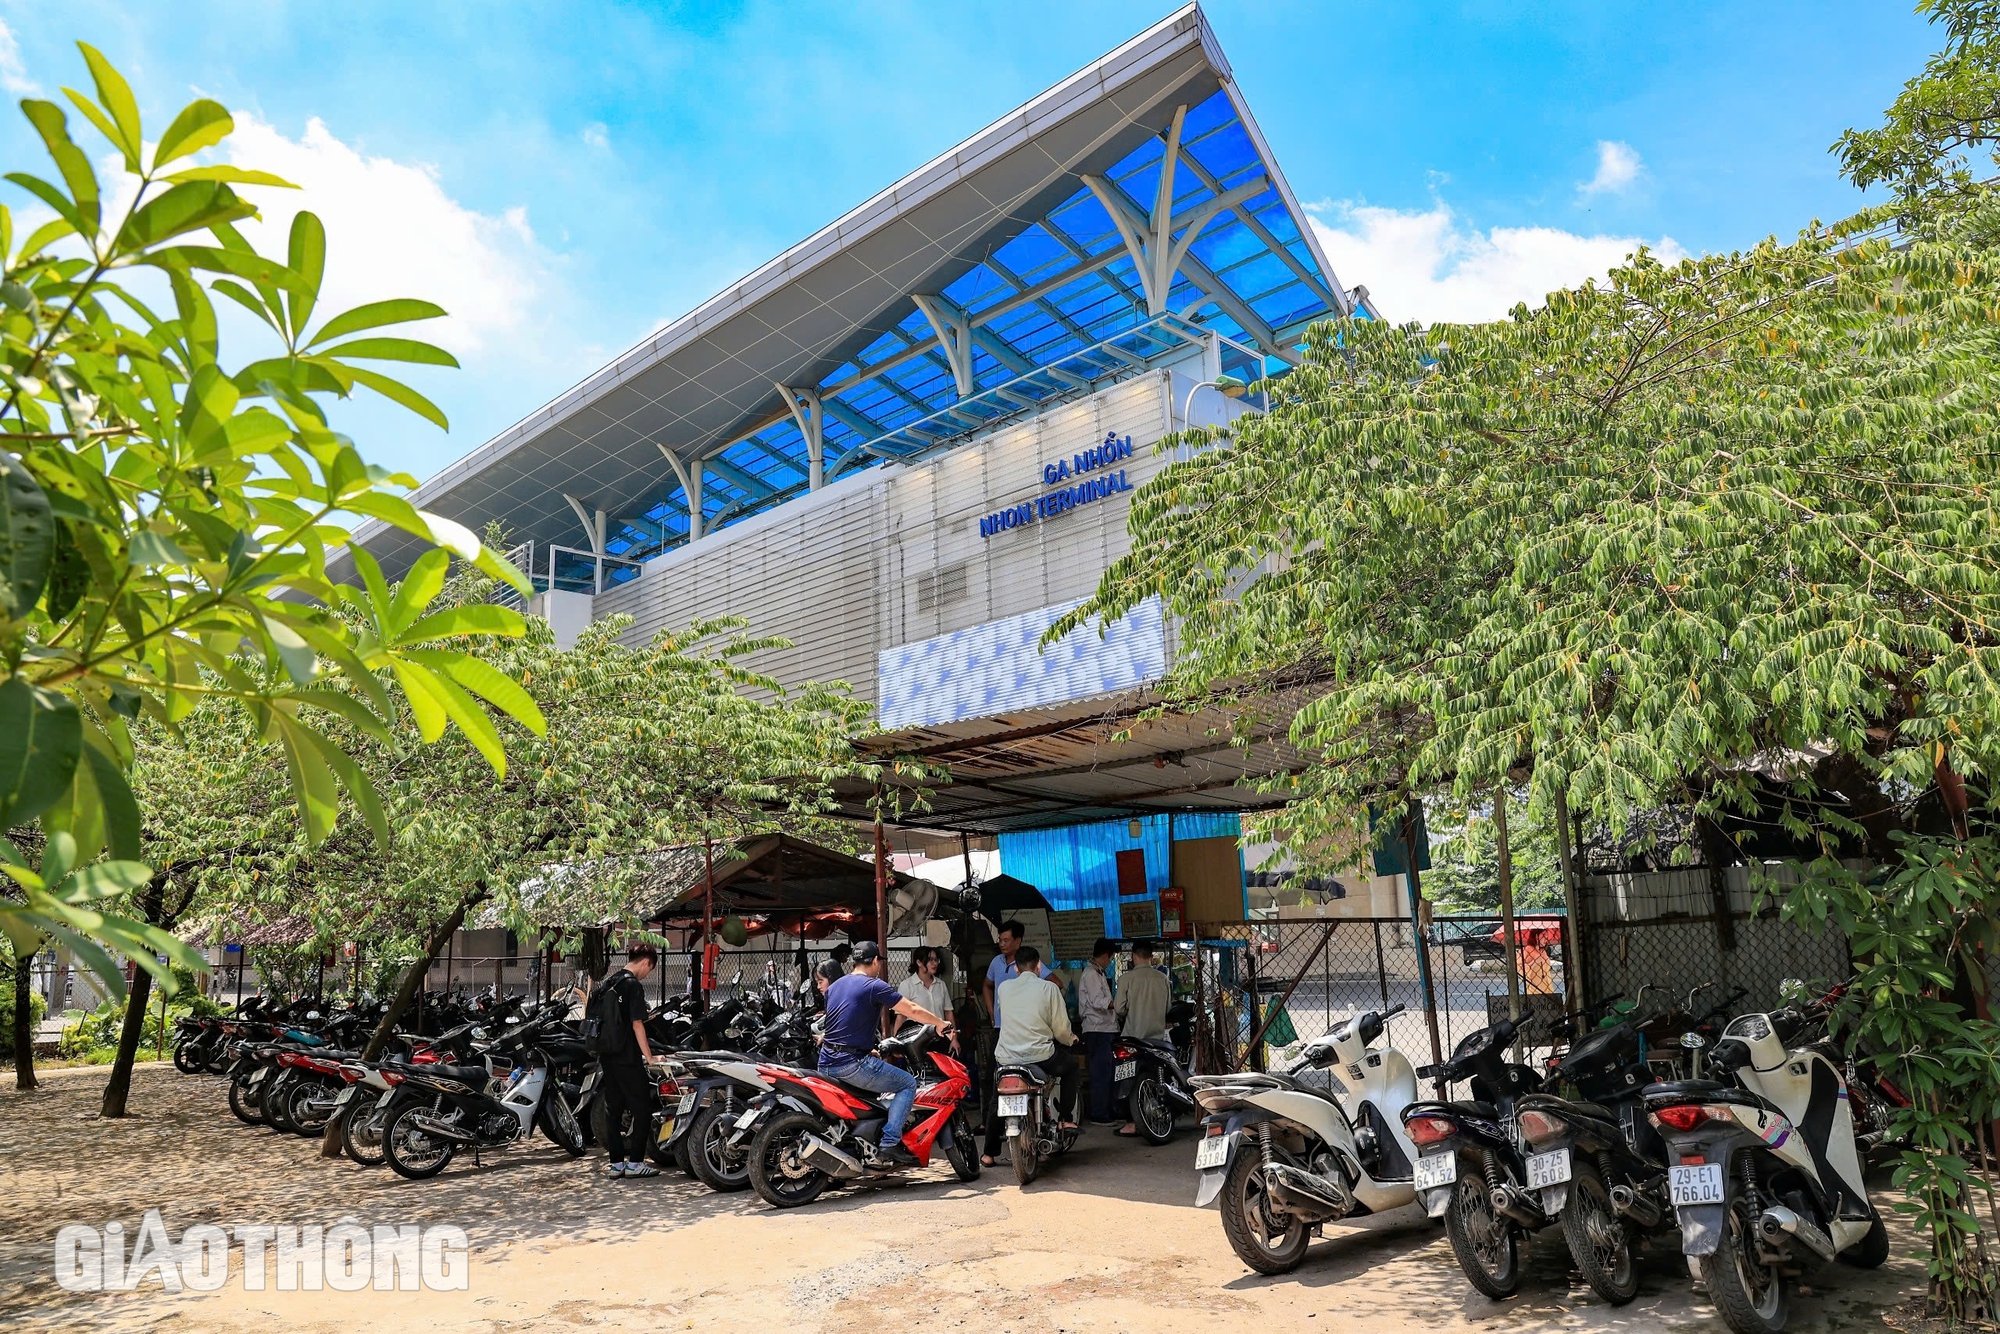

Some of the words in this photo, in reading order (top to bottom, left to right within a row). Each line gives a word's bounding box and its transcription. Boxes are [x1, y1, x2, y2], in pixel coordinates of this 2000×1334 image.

[1043, 459, 1070, 485] GA
[980, 502, 1031, 538] NHON
[1035, 469, 1134, 519] TERMINAL
[1002, 1106, 1023, 1115] 6181
[1197, 1151, 1225, 1167] 531.84
[1419, 1154, 1447, 1172] 99-E1
[1532, 1152, 1562, 1171] 30-Z5
[1416, 1168, 1453, 1188] 641.52
[1533, 1166, 1565, 1186] 2608
[1676, 1166, 1713, 1185] 29-E1
[1673, 1184, 1720, 1203] 766.04
